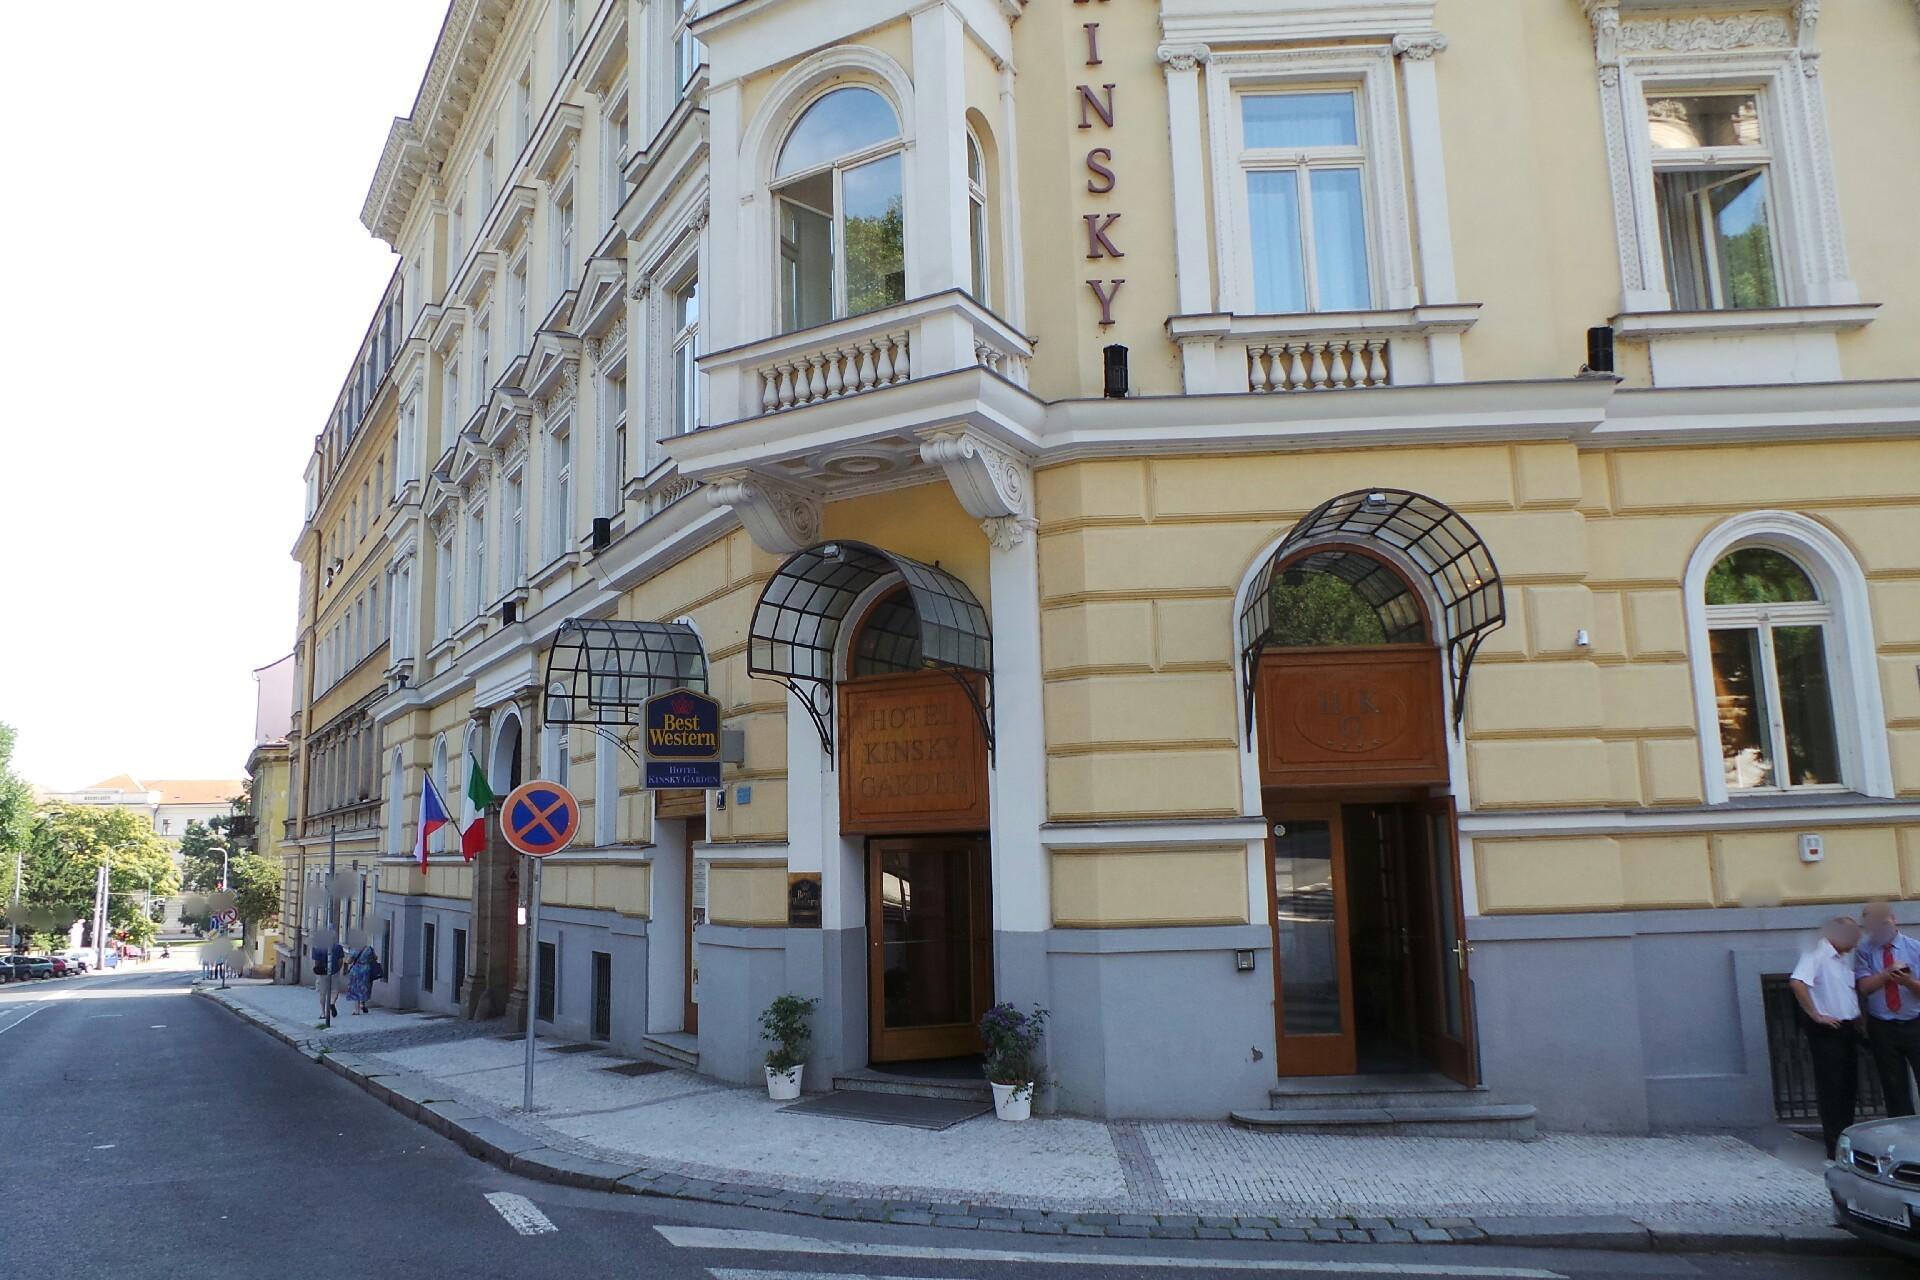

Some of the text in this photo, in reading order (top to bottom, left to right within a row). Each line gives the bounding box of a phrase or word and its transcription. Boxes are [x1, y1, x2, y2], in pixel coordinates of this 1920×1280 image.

[1072, 0, 1126, 325] INSKY
[664, 714, 700, 730] Best
[868, 703, 960, 732] HOTEL
[650, 729, 716, 746] Western
[863, 736, 961, 764] KINSKY
[648, 775, 719, 784] KINSKY GARDEN
[669, 766, 698, 774] HOTEL
[861, 772, 969, 799] GARDEN
